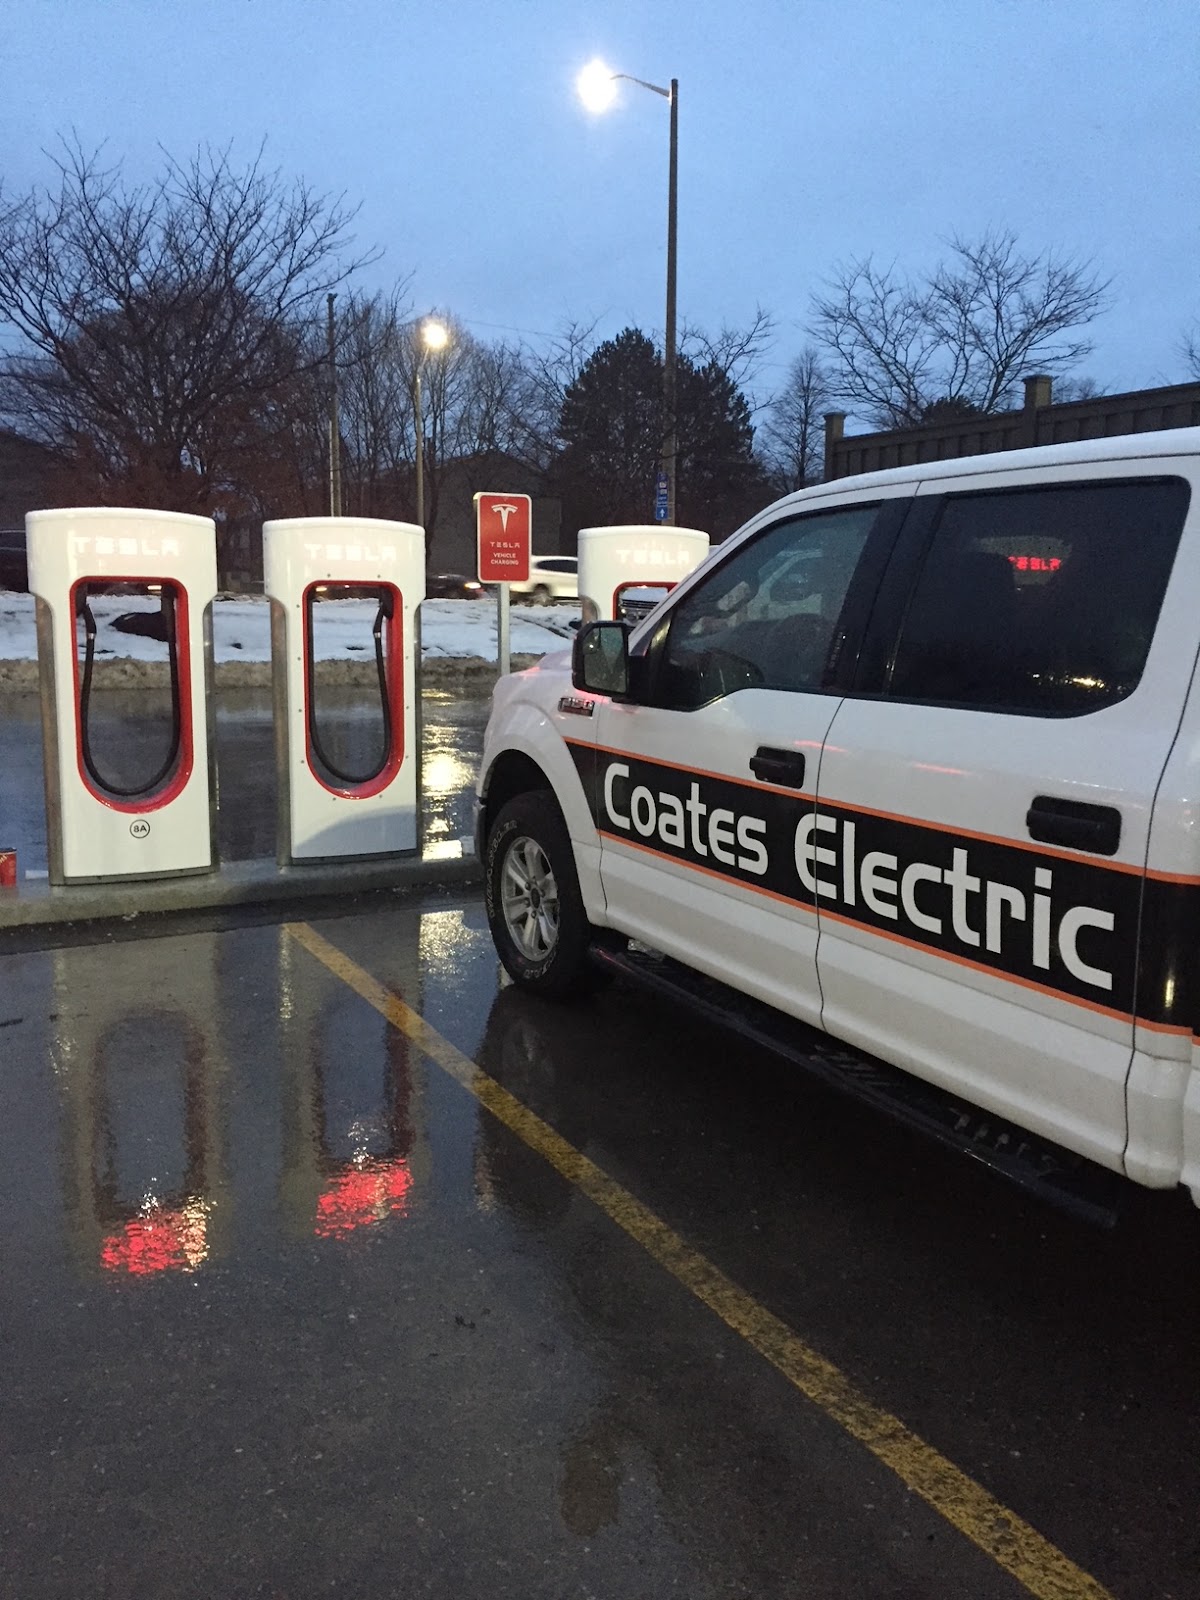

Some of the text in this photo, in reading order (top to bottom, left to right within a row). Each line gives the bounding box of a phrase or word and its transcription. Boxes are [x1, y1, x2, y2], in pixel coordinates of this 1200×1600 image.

[71, 536, 180, 556] TESLA
[303, 543, 397, 561] TESLA
[490, 541, 521, 549] TESLA
[615, 549, 690, 565] TESLA
[133, 824, 148, 833] 8A
[603, 762, 1115, 990] Coates Electric
